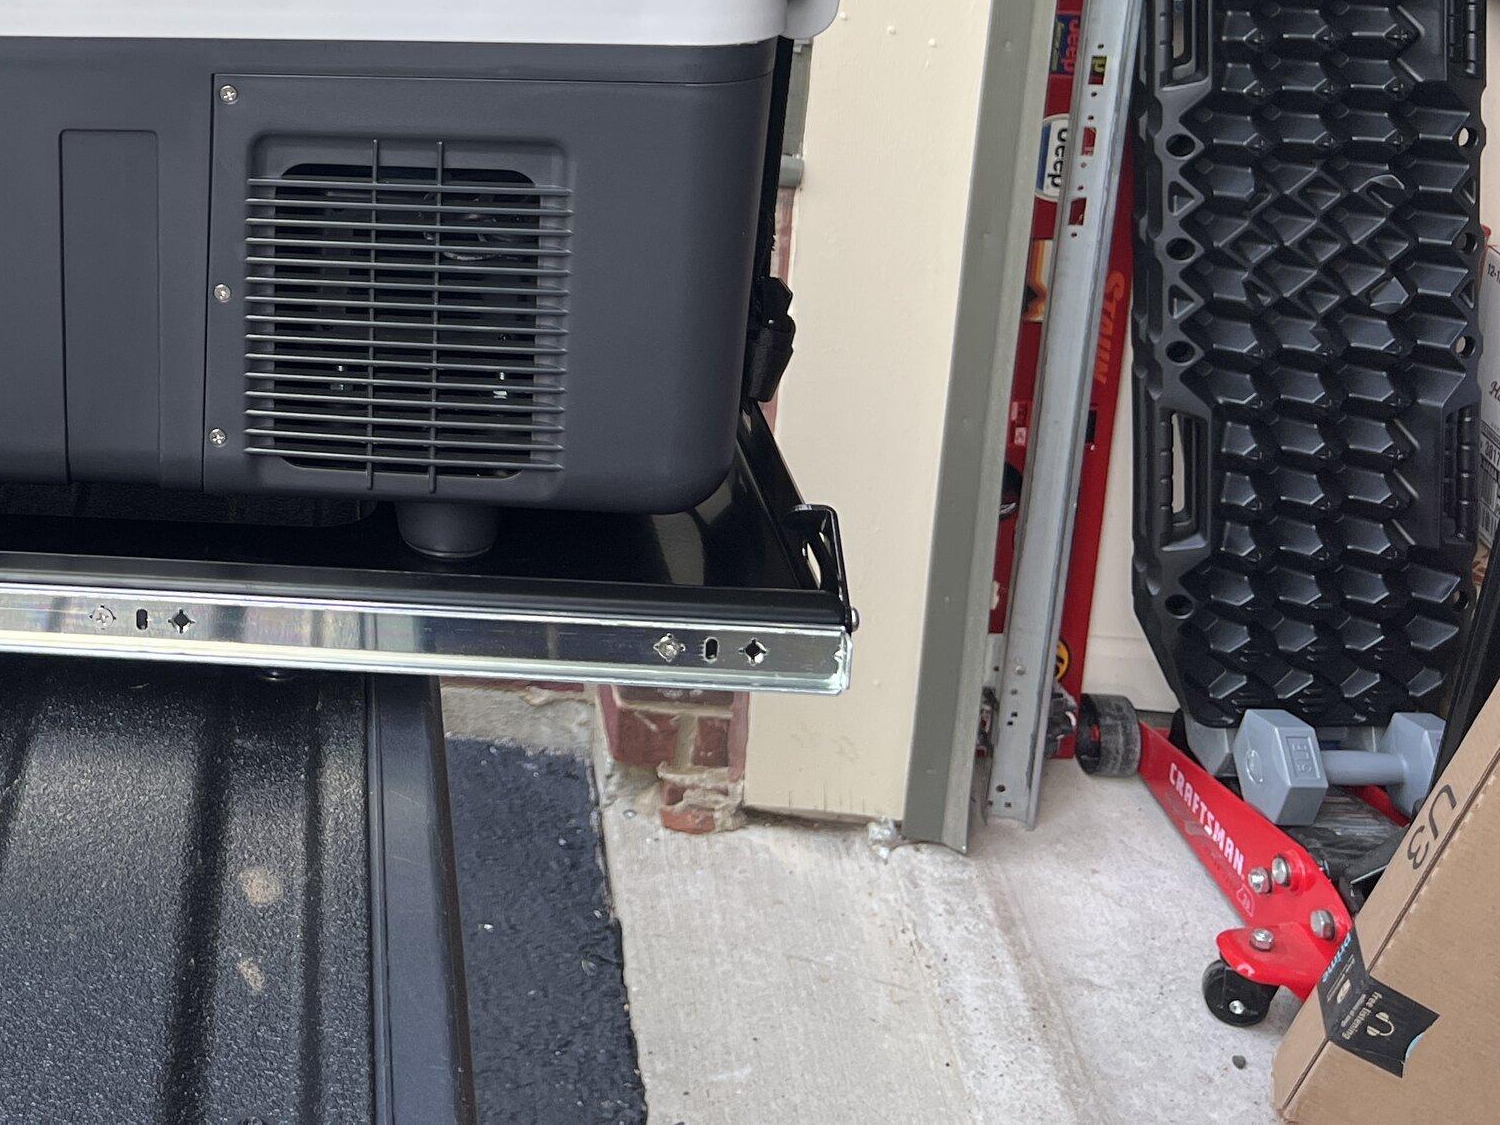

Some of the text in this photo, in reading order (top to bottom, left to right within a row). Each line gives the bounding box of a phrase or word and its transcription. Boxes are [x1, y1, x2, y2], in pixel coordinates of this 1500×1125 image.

[1167, 762, 1246, 876] CRAFTSMAN
[1366, 991, 1383, 1009] free
[1341, 1006, 1373, 1040] listening
